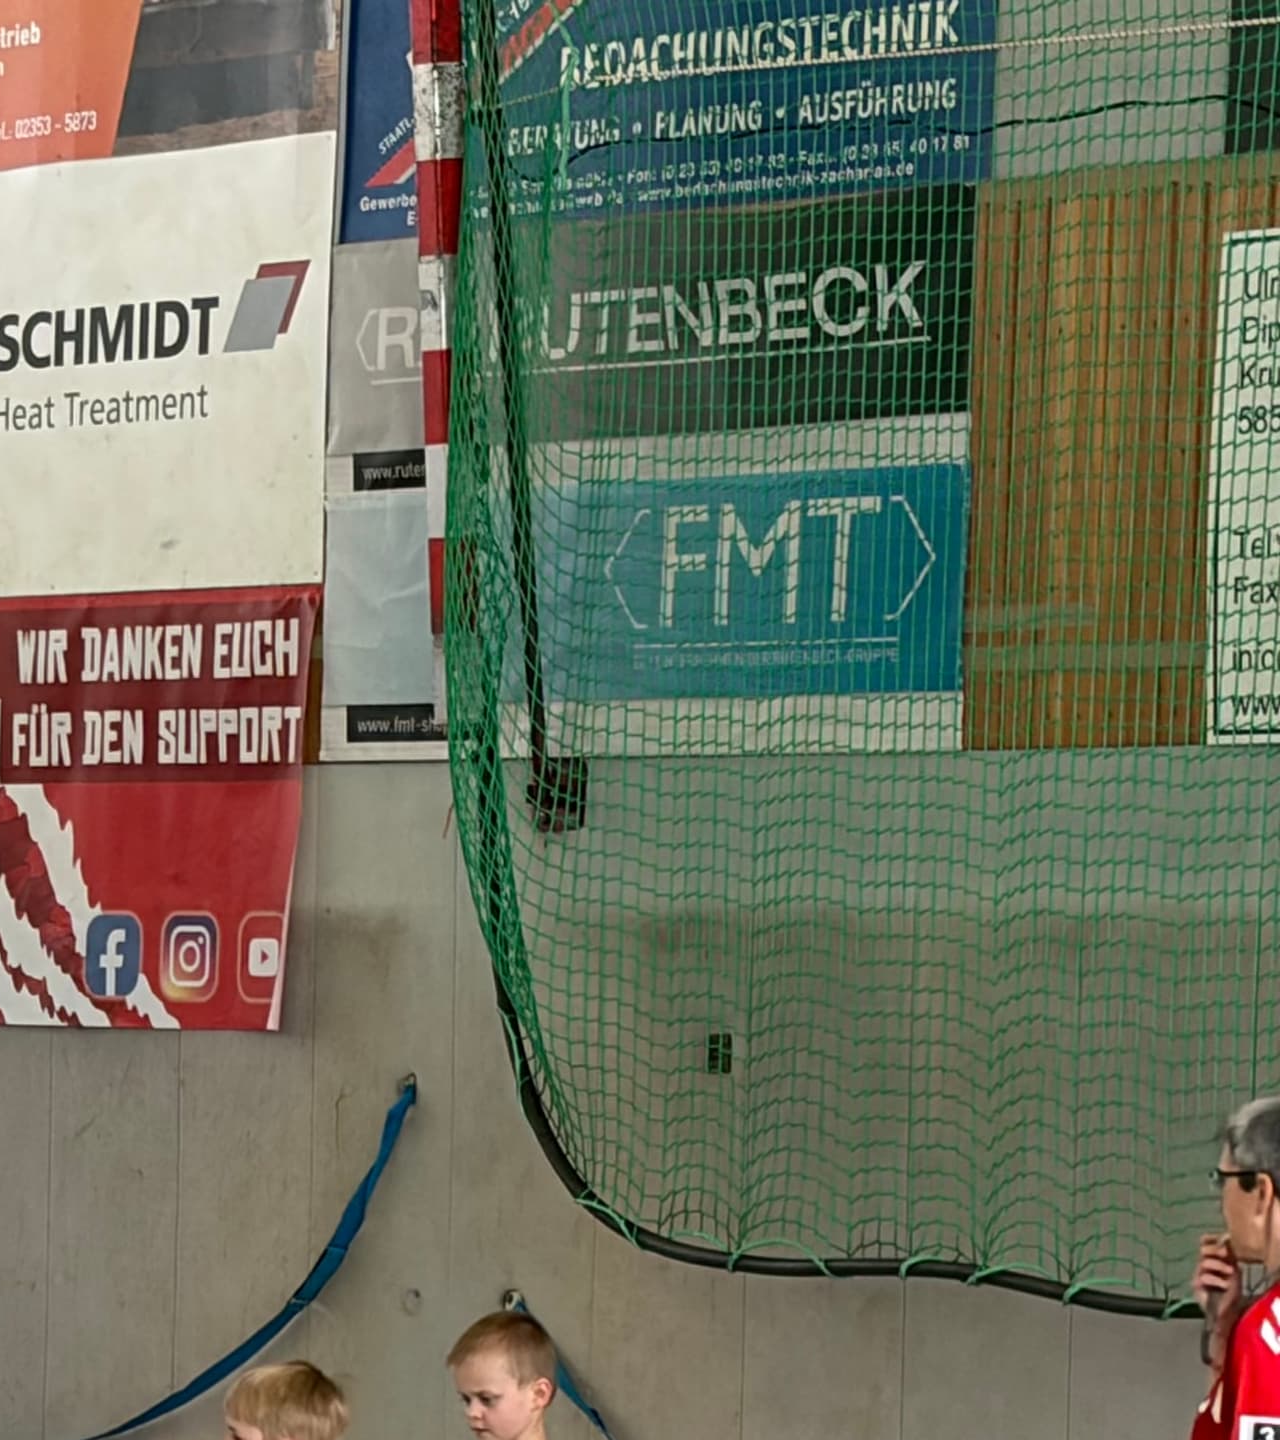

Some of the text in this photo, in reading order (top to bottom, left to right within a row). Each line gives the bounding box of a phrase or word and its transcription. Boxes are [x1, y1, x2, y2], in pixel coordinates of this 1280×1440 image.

[655, 100, 763, 139] PLANUNG
[797, 78, 957, 124] AUSFÜHRUNG
[542, 260, 925, 361] UTENBECK
[64, 384, 209, 428] Treatment
[660, 496, 882, 628] FMT
[16, 617, 299, 684] WIR DANKEN EUCH
[12, 702, 303, 768] FÜR DEN SUPPORT
